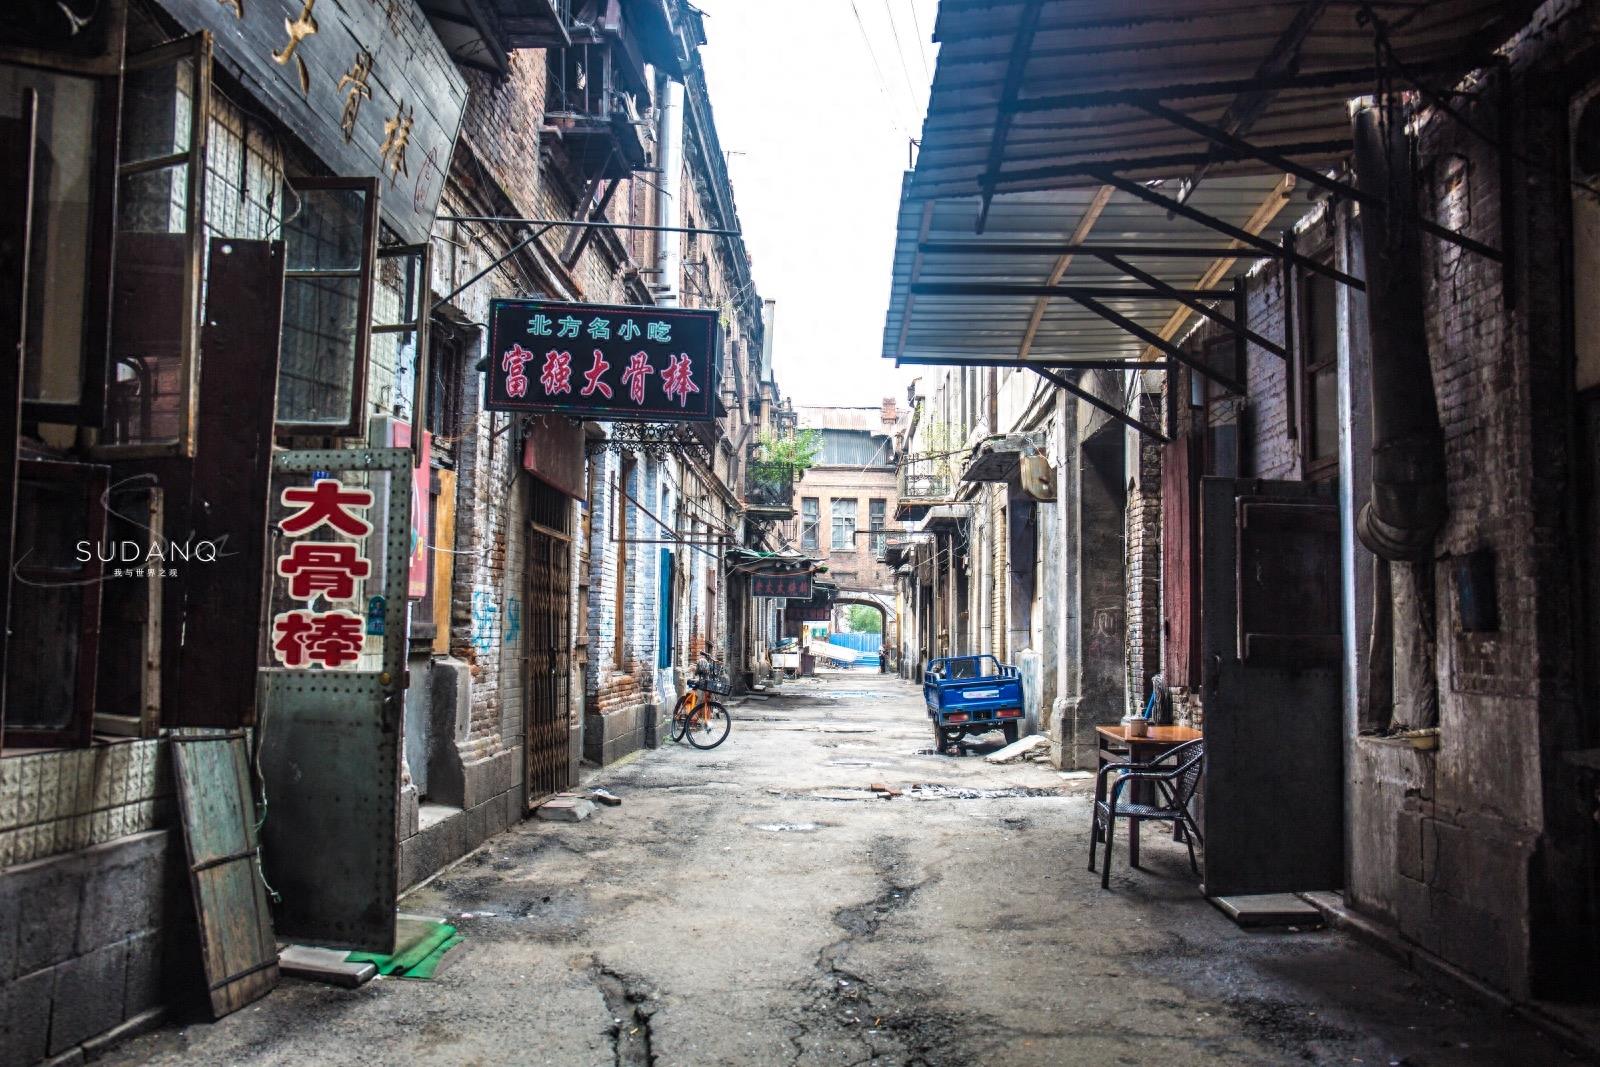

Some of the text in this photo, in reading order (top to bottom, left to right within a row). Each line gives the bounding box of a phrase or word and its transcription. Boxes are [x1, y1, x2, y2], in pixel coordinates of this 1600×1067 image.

[218, 0, 414, 192] 大骨棒
[502, 344, 700, 407] 富强大骨棒
[527, 314, 672, 342] 北方名小吃
[273, 479, 375, 669] 大骨棒
